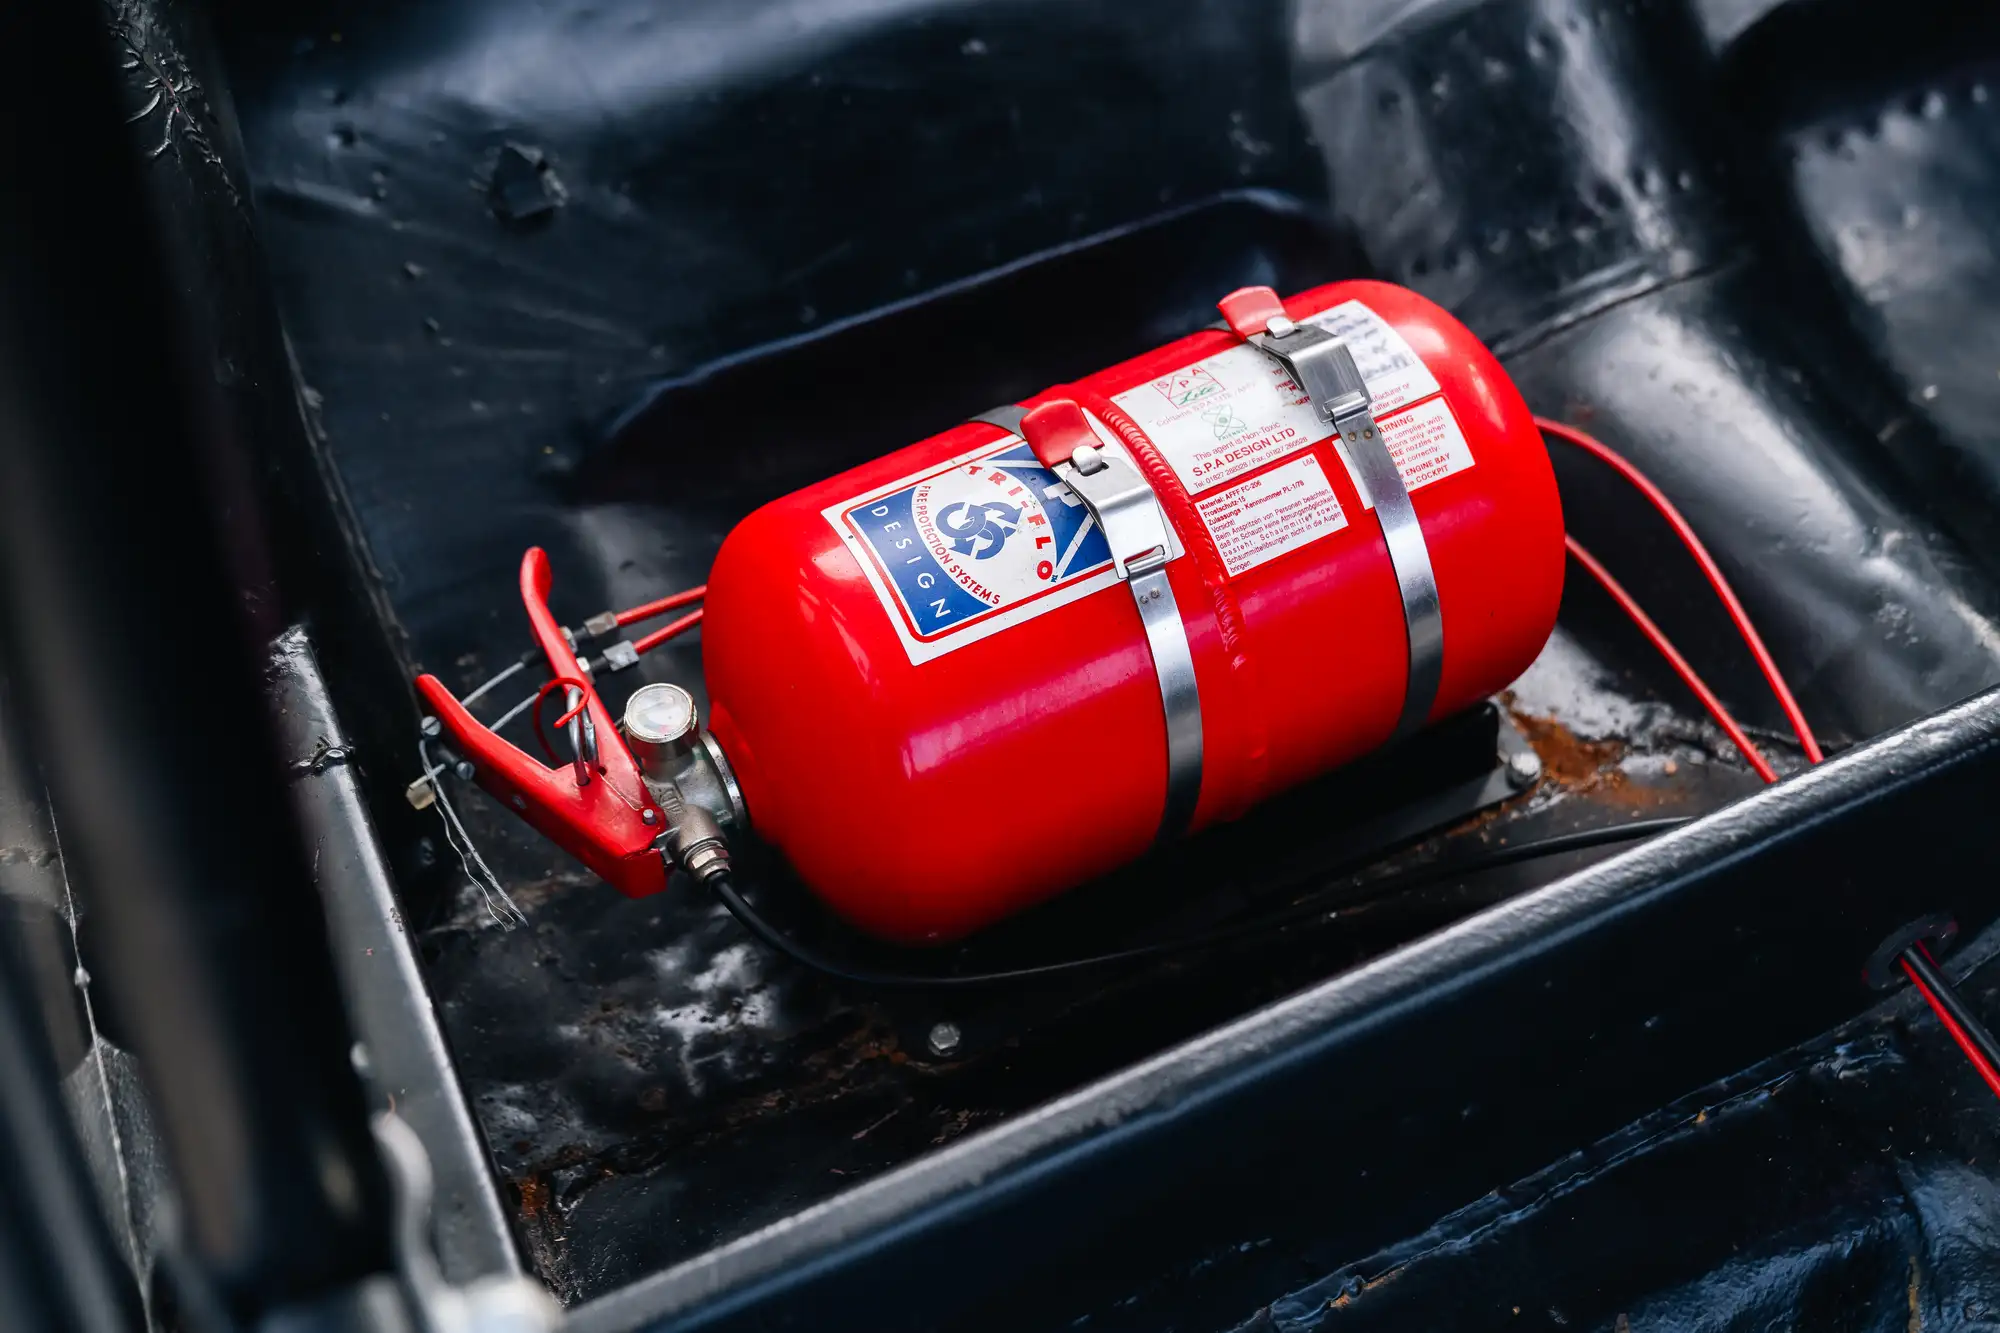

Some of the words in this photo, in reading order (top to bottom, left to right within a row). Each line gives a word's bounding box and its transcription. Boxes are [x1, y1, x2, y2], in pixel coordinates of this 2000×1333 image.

[1379, 414, 1415, 434] ARNING
[1394, 423, 1426, 439] complies
[1426, 415, 1443, 426] with
[1427, 423, 1446, 435] when
[1192, 451, 1213, 462] This
[1211, 440, 1235, 455] agent
[1241, 422, 1281, 442] Non-Toxic
[1192, 457, 1225, 477] S.P.A
[1223, 437, 1272, 464] DESIGN
[1271, 427, 1296, 444] LTD
[1405, 438, 1432, 453] nozzles
[1404, 459, 1434, 477] ENGINE
[1434, 452, 1450, 465] BAY
[1415, 464, 1449, 483] COCKPIT
[1193, 480, 1205, 489] Tel:
[1205, 471, 1224, 484] 01827
[916, 485, 932, 503] FIRE
[1199, 497, 1225, 511] Material:
[1224, 487, 1241, 501] AFFF
[1240, 479, 1263, 494] FC-206
[1206, 507, 1242, 527] Zulassungs
[1214, 531, 1232, 542] Beim
[1231, 517, 1263, 535] Anspritzen
[1262, 512, 1275, 521] von
[1274, 500, 1303, 516] Personen
[1316, 503, 1339, 517] sowie
[916, 504, 953, 565] PROTECTION
[1210, 518, 1236, 534] Vorsicht!
[1230, 536, 1241, 544] im
[1239, 526, 1265, 541] Schaum
[1263, 519, 1281, 530] keine
[1290, 526, 1306, 538] nicht
[1312, 519, 1323, 528] die
[1323, 511, 1342, 524] Augen
[871, 505, 951, 618] DESIGN
[1229, 560, 1253, 574] bringen.
[949, 564, 1001, 605] SYSTEMS
